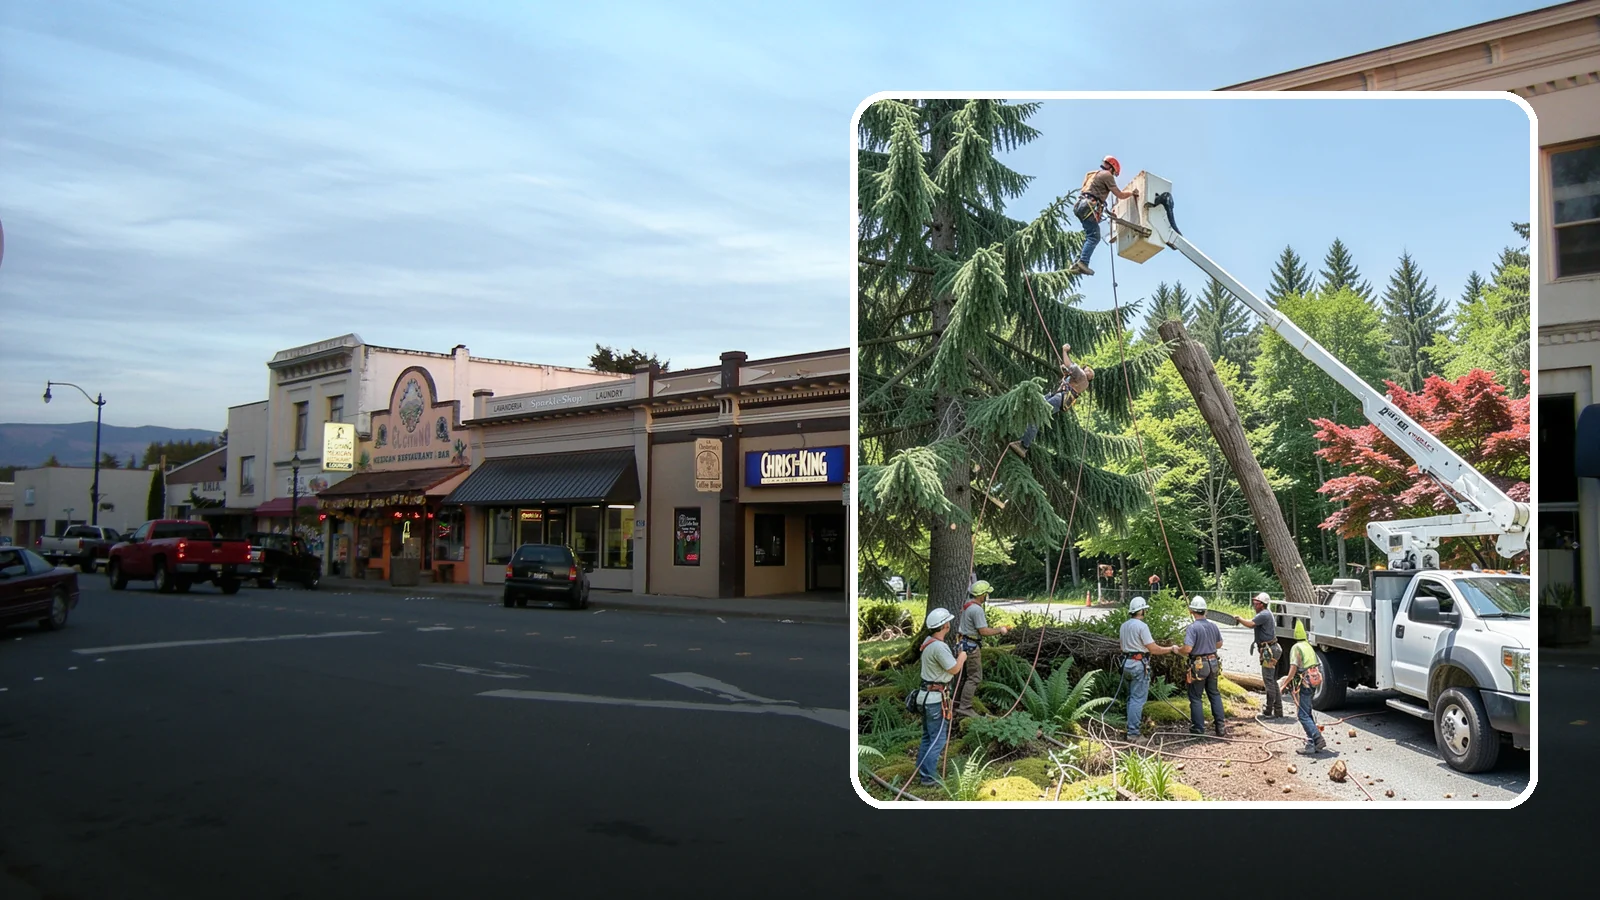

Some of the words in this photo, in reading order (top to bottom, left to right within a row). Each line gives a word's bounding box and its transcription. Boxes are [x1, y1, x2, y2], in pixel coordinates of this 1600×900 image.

[595, 389, 624, 400] LAUNDRY
[493, 402, 523, 412] LAVANDERIA
[373, 454, 397, 464] MEXICAN
[397, 451, 434, 462] RESTAURANT
[437, 450, 450, 459] BAR
[760, 451, 798, 478] CHRIST
[799, 450, 828, 476] KING
